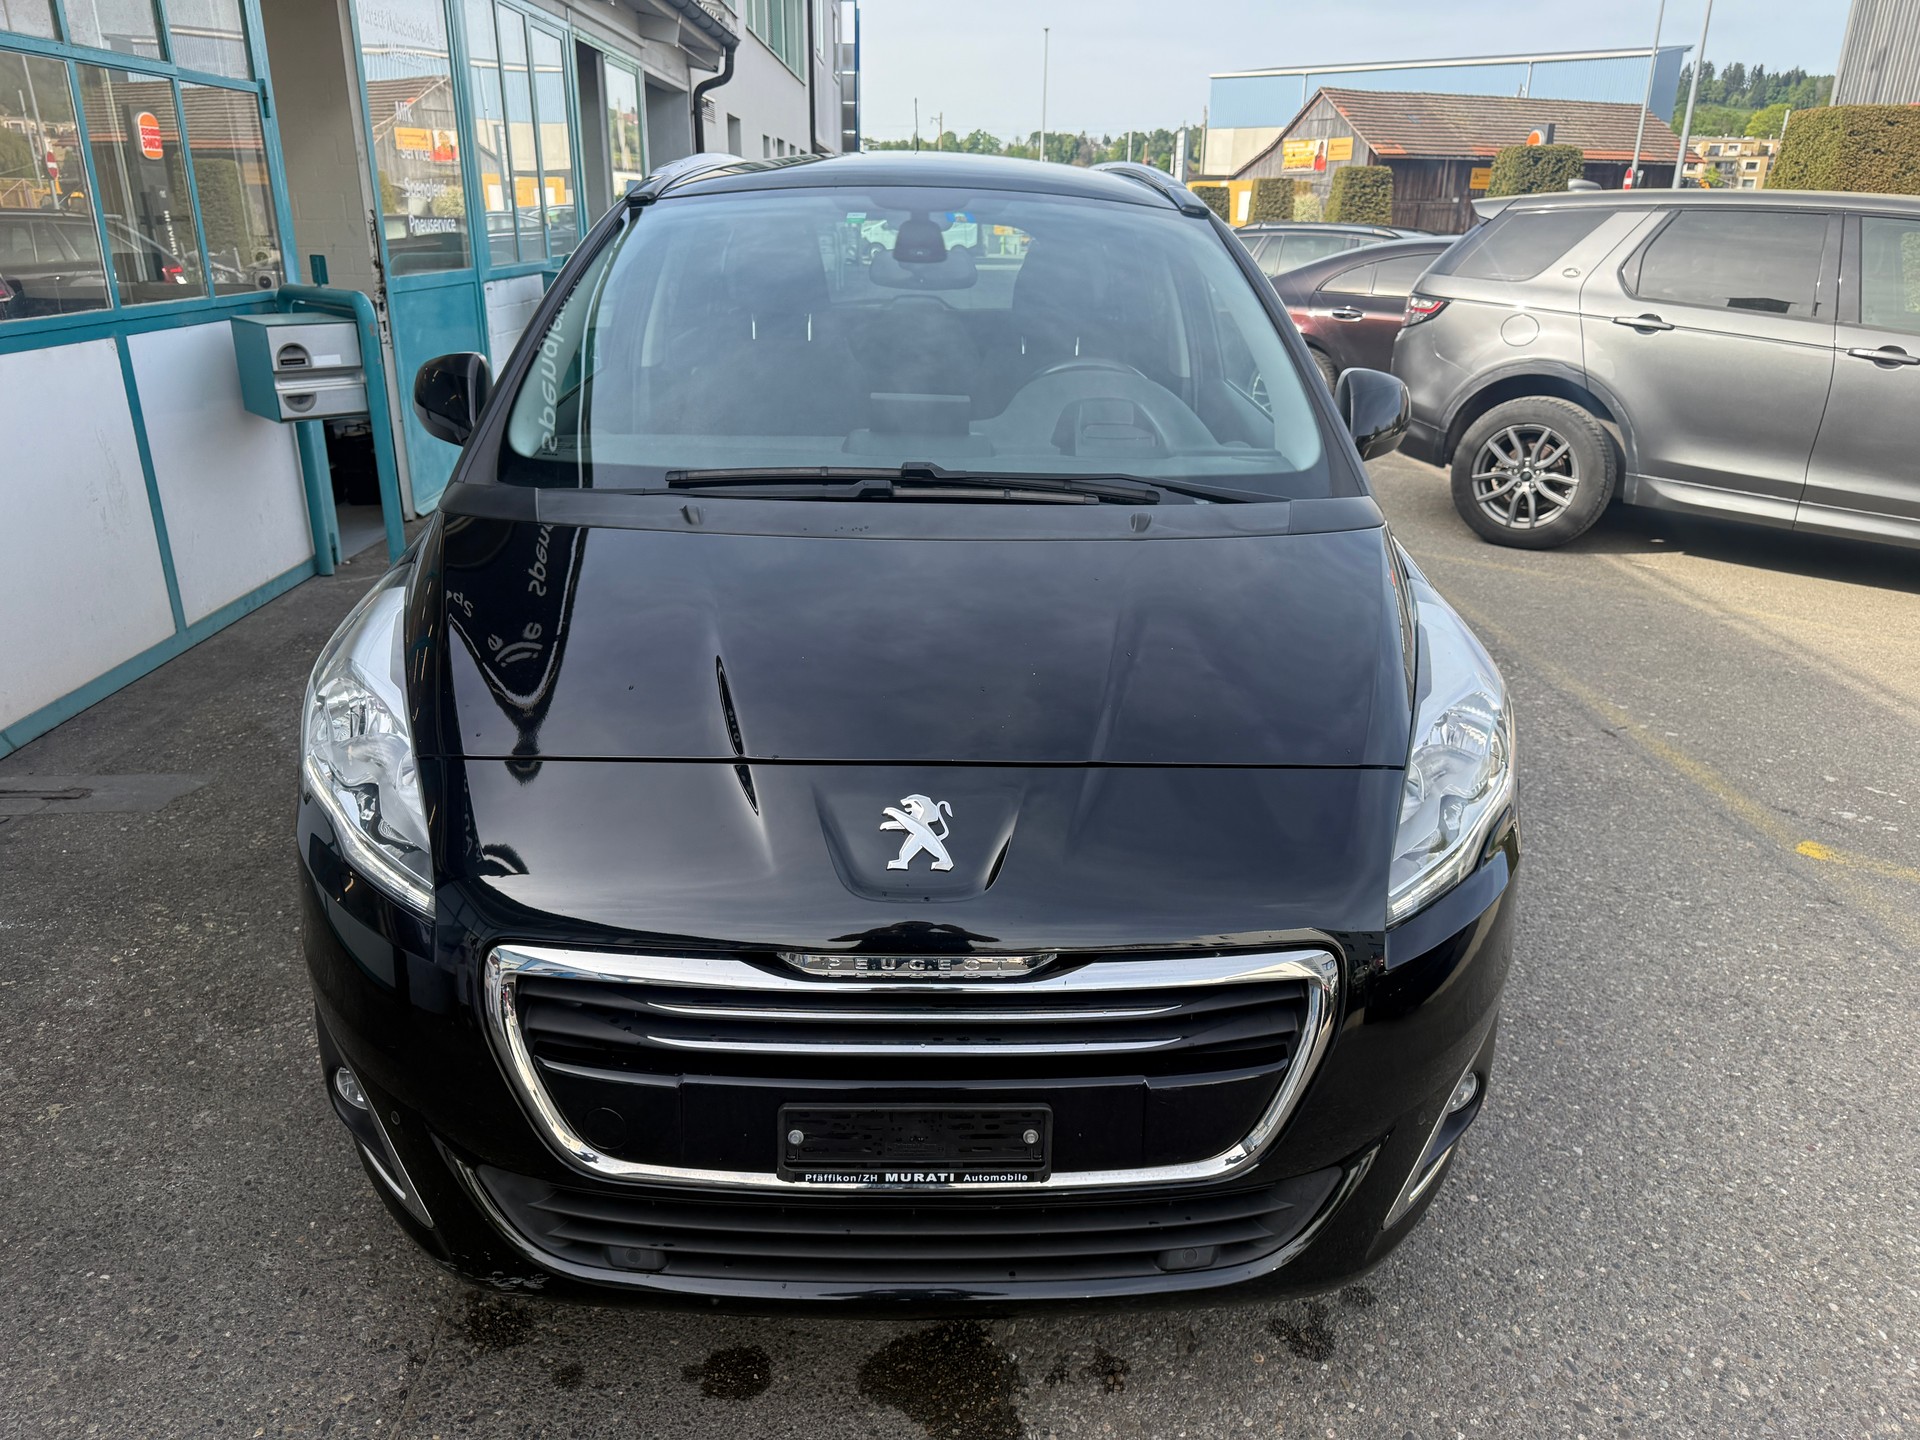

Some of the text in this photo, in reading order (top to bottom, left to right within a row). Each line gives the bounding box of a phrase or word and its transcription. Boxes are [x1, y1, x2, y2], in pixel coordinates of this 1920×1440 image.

[408, 214, 457, 233] Pneuservice
[827, 957, 1009, 971] PEUGEOT
[805, 1172, 1028, 1183] Pfäffikon/ZH MURATI Automobile
